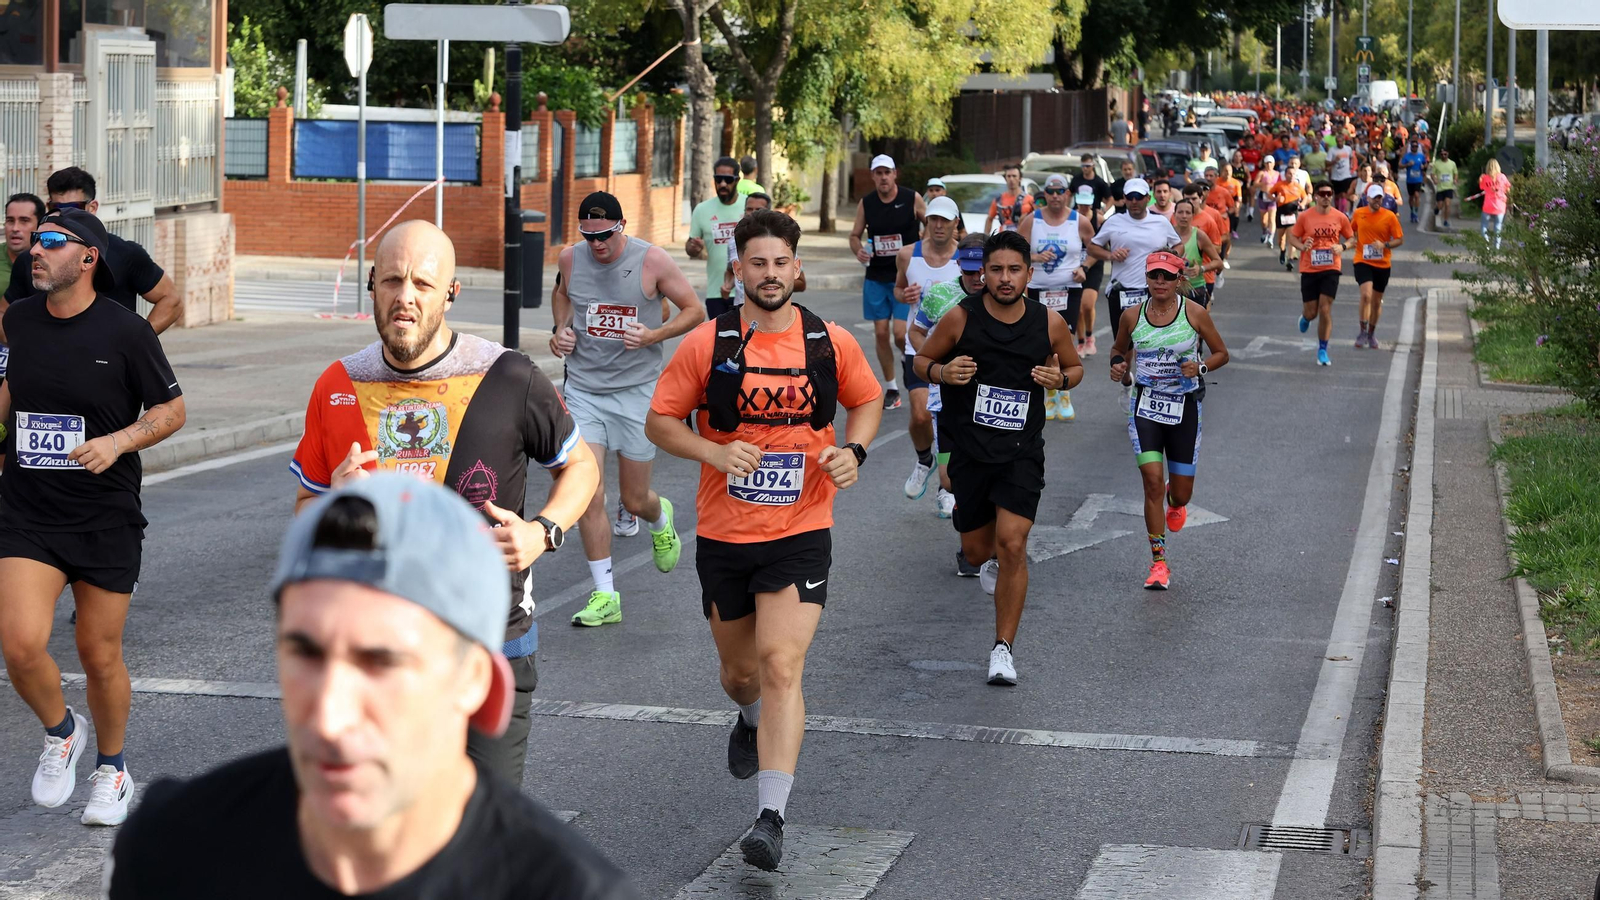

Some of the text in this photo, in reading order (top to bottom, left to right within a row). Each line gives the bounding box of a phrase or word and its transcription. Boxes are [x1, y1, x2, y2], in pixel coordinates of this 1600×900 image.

[599, 315, 624, 329] 231
[985, 399, 1020, 417] 1046
[1149, 400, 1172, 414] 891
[992, 419, 1022, 427] MIZUNO
[1153, 413, 1179, 423] MIZUNO
[29, 432, 66, 452] 840
[397, 449, 430, 459] RUNNER
[743, 470, 792, 488] 1094
[753, 493, 797, 502] MIZUNO
